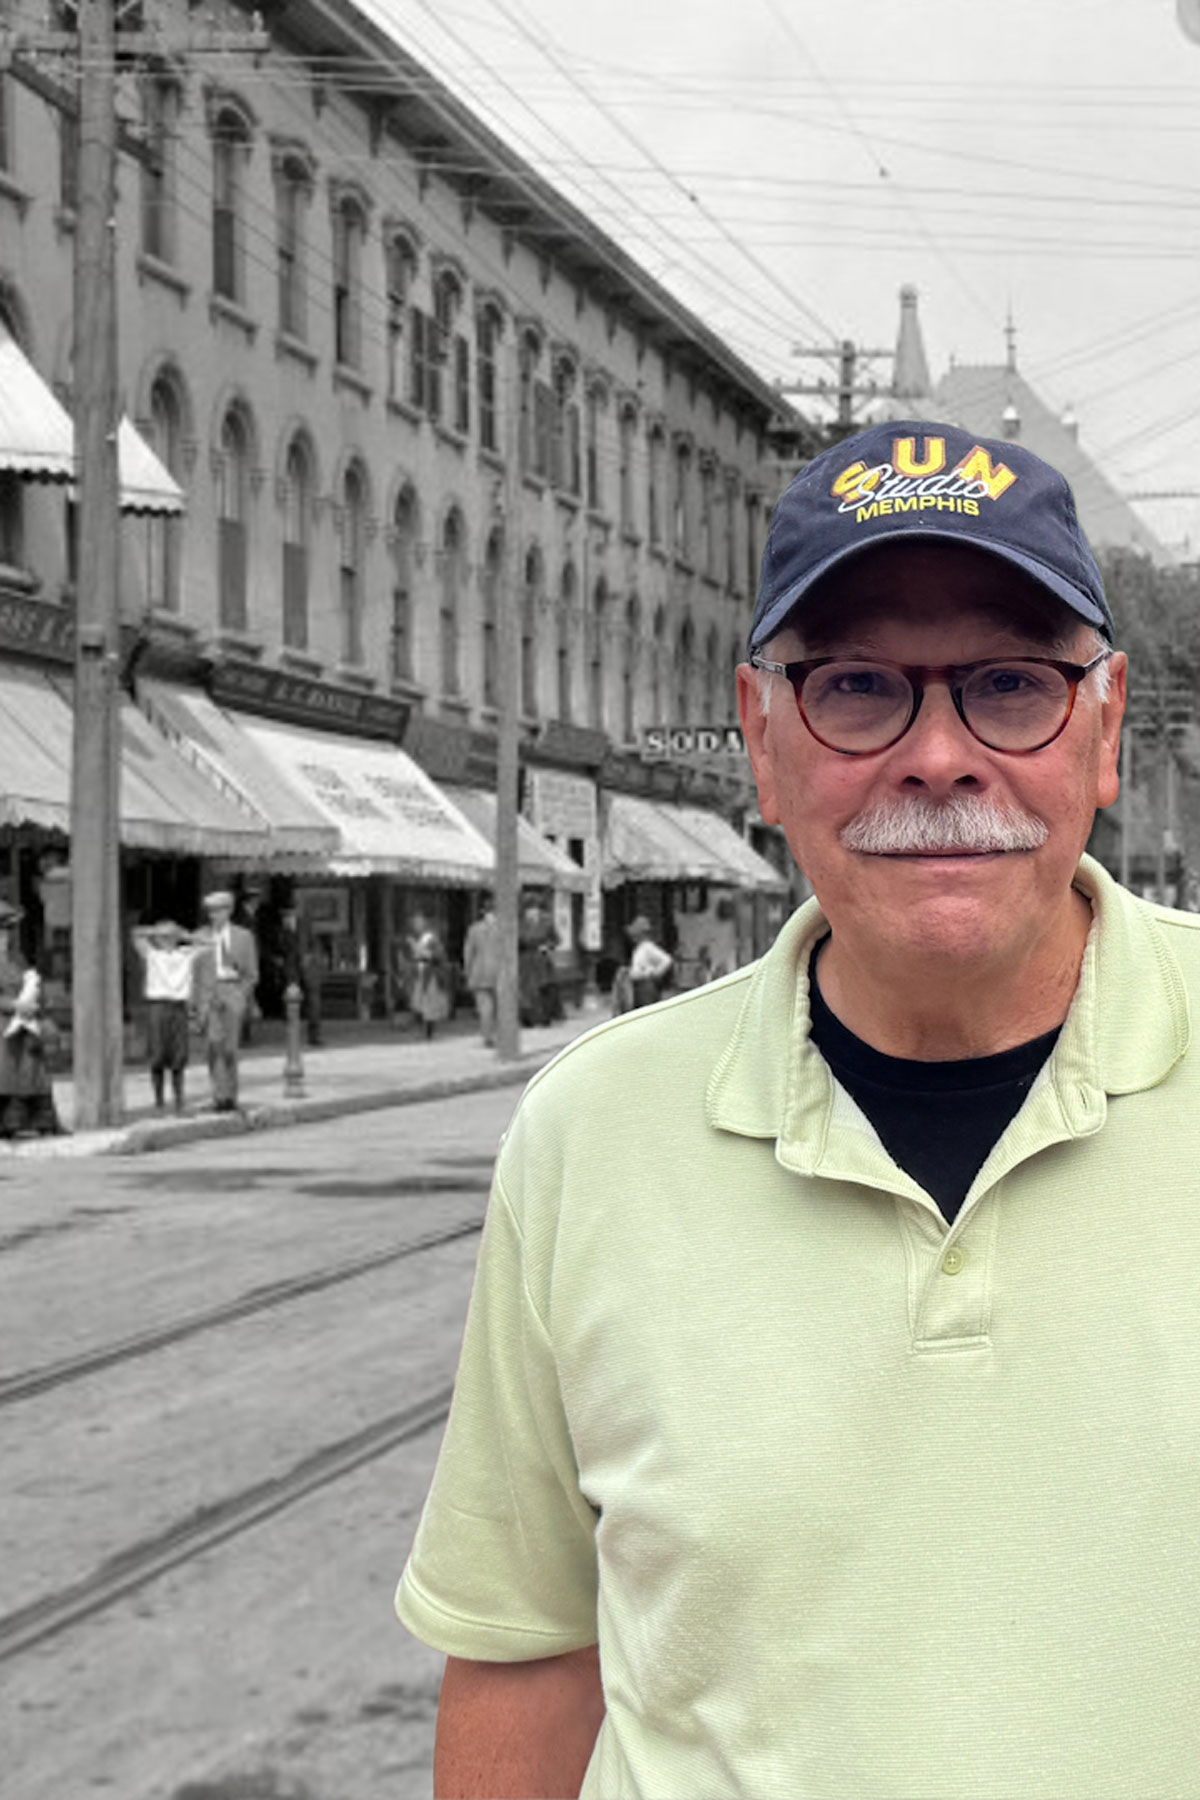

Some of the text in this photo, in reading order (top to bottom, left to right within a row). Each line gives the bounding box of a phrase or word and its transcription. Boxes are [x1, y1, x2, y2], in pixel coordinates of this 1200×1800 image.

[831, 437, 1017, 501] SUN
[838, 463, 989, 513] Studio
[856, 496, 980, 523] MEMPHIS
[648, 731, 741, 753] SODA
